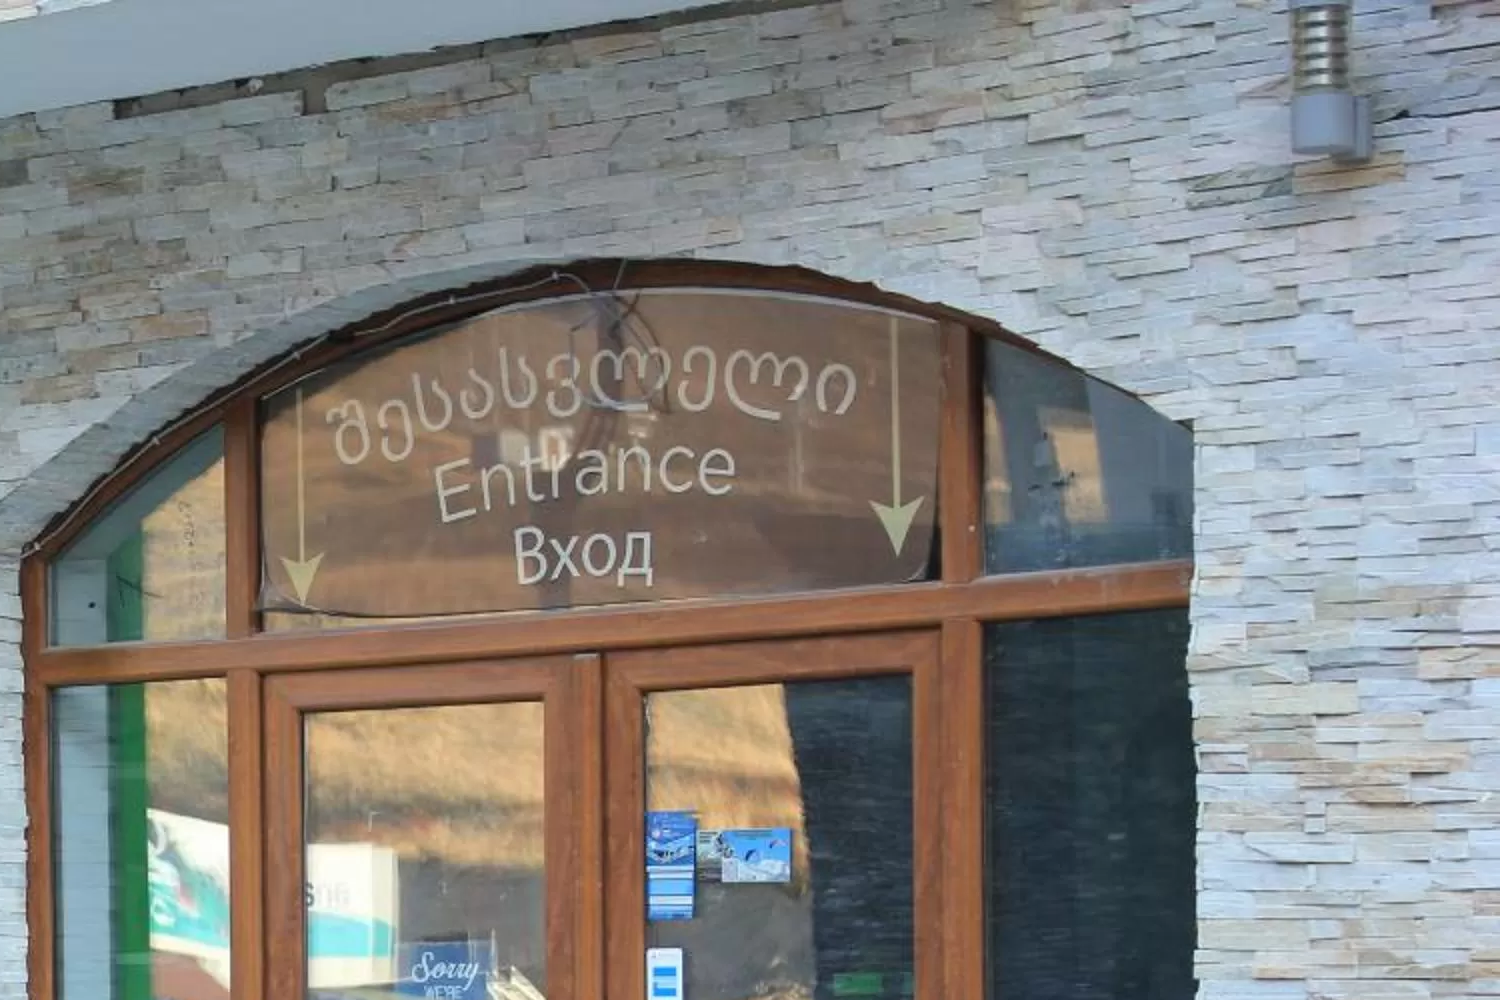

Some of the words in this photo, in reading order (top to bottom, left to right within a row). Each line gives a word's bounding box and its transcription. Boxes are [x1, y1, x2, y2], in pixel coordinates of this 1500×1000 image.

[326, 345, 857, 464] შესასვლელი
[434, 444, 736, 523] Entrance
[513, 526, 654, 588] Вход
[411, 951, 480, 992] Sorry
